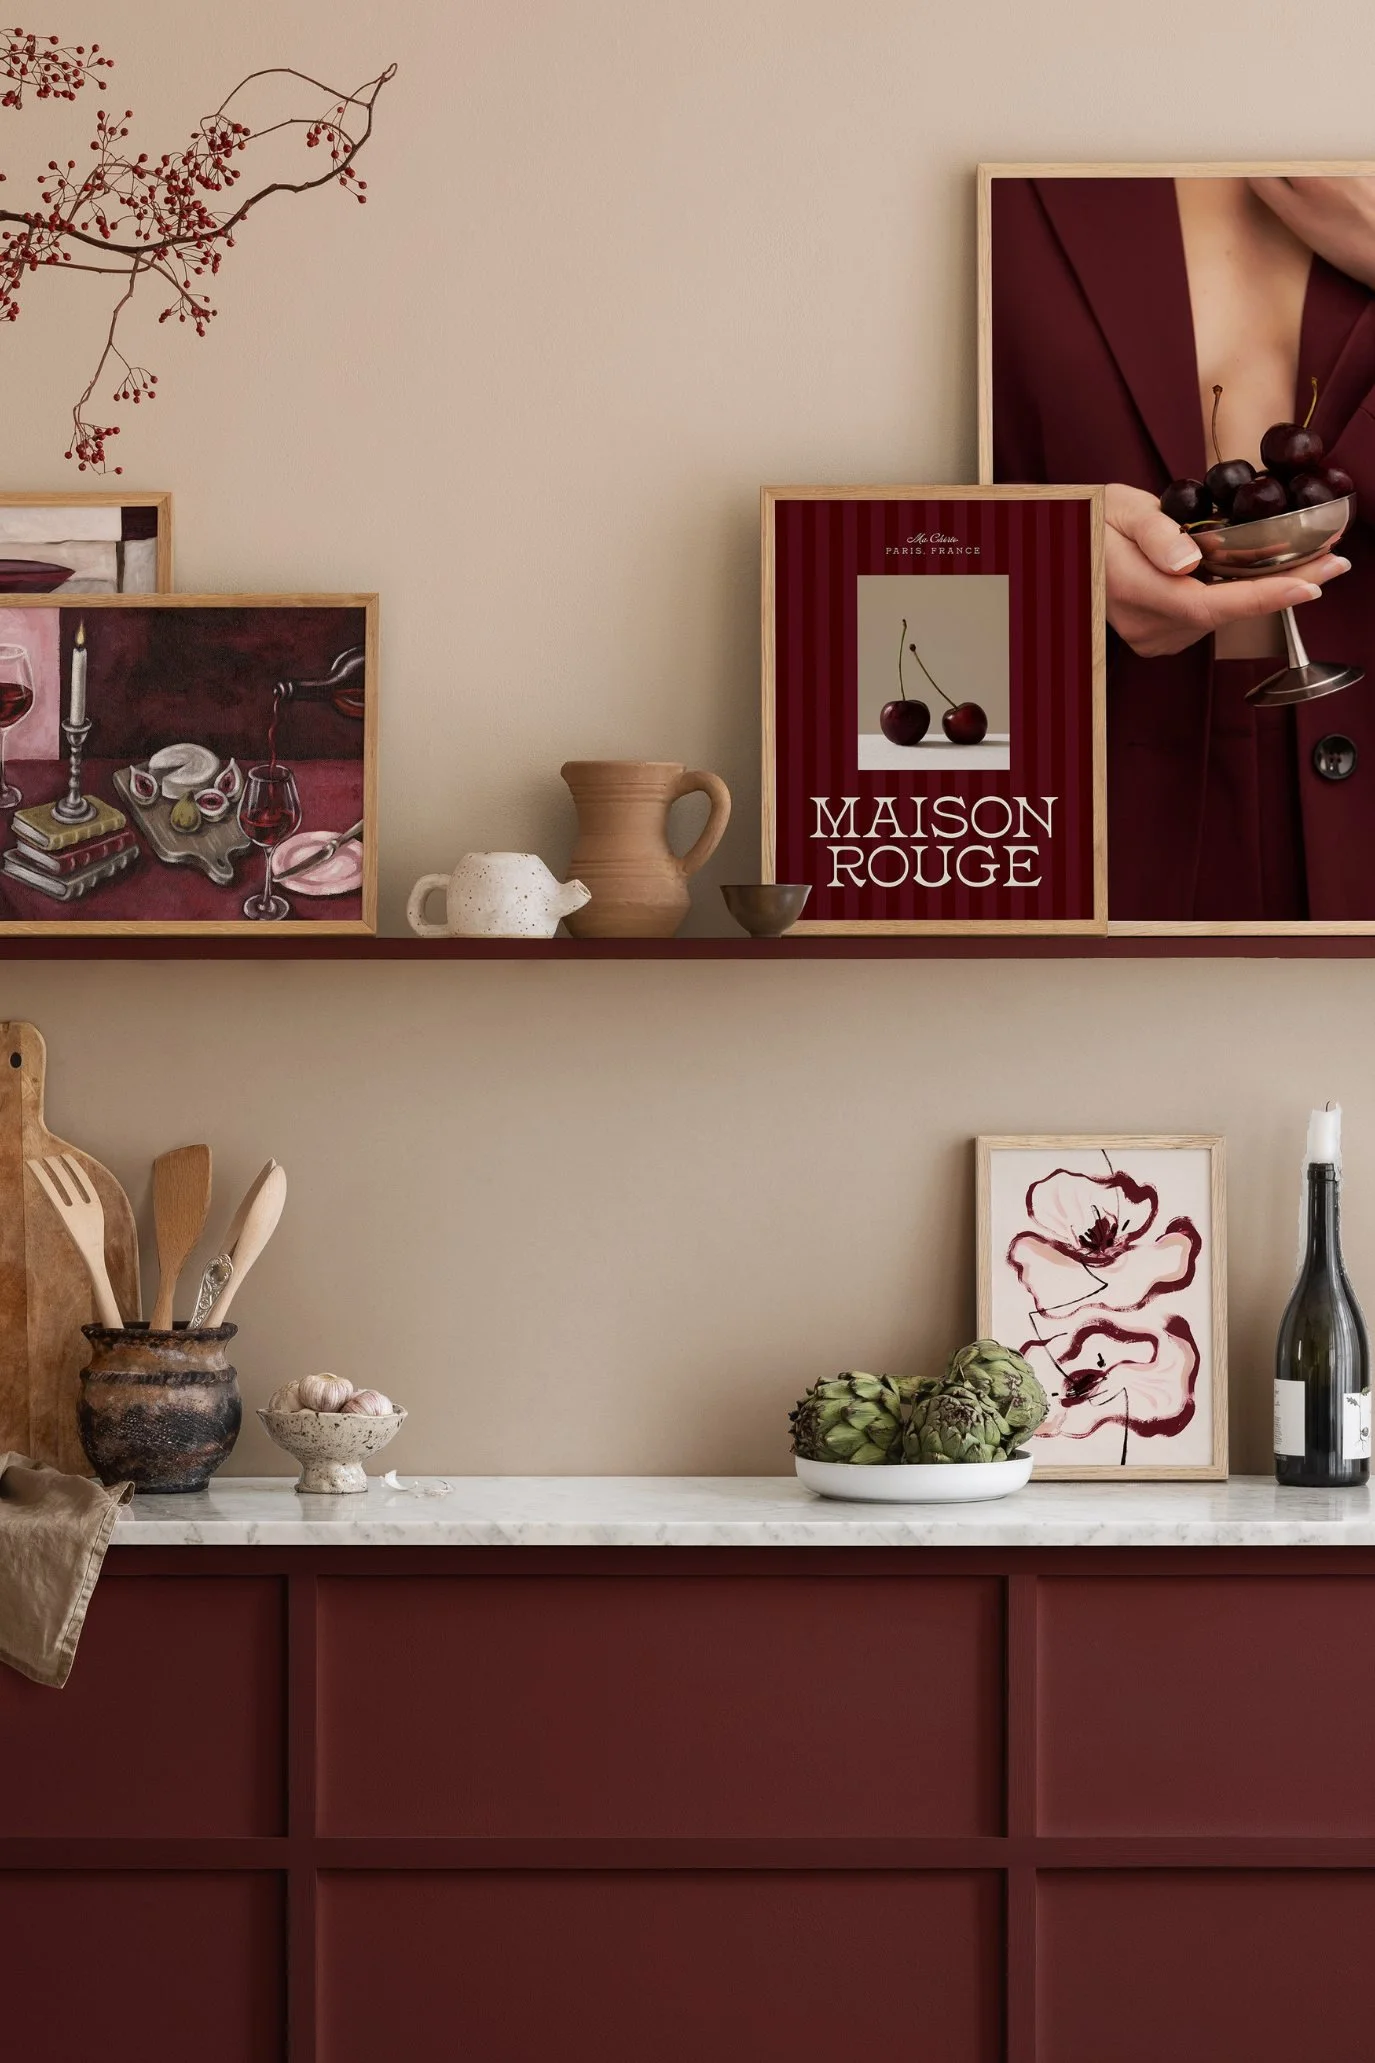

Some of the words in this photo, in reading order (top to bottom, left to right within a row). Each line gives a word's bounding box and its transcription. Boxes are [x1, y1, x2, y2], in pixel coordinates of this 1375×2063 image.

[906, 532, 928, 545] Ma
[931, 546, 981, 555] FRANCE
[810, 796, 1058, 838] MAISON
[827, 845, 1042, 887] ROUGE
